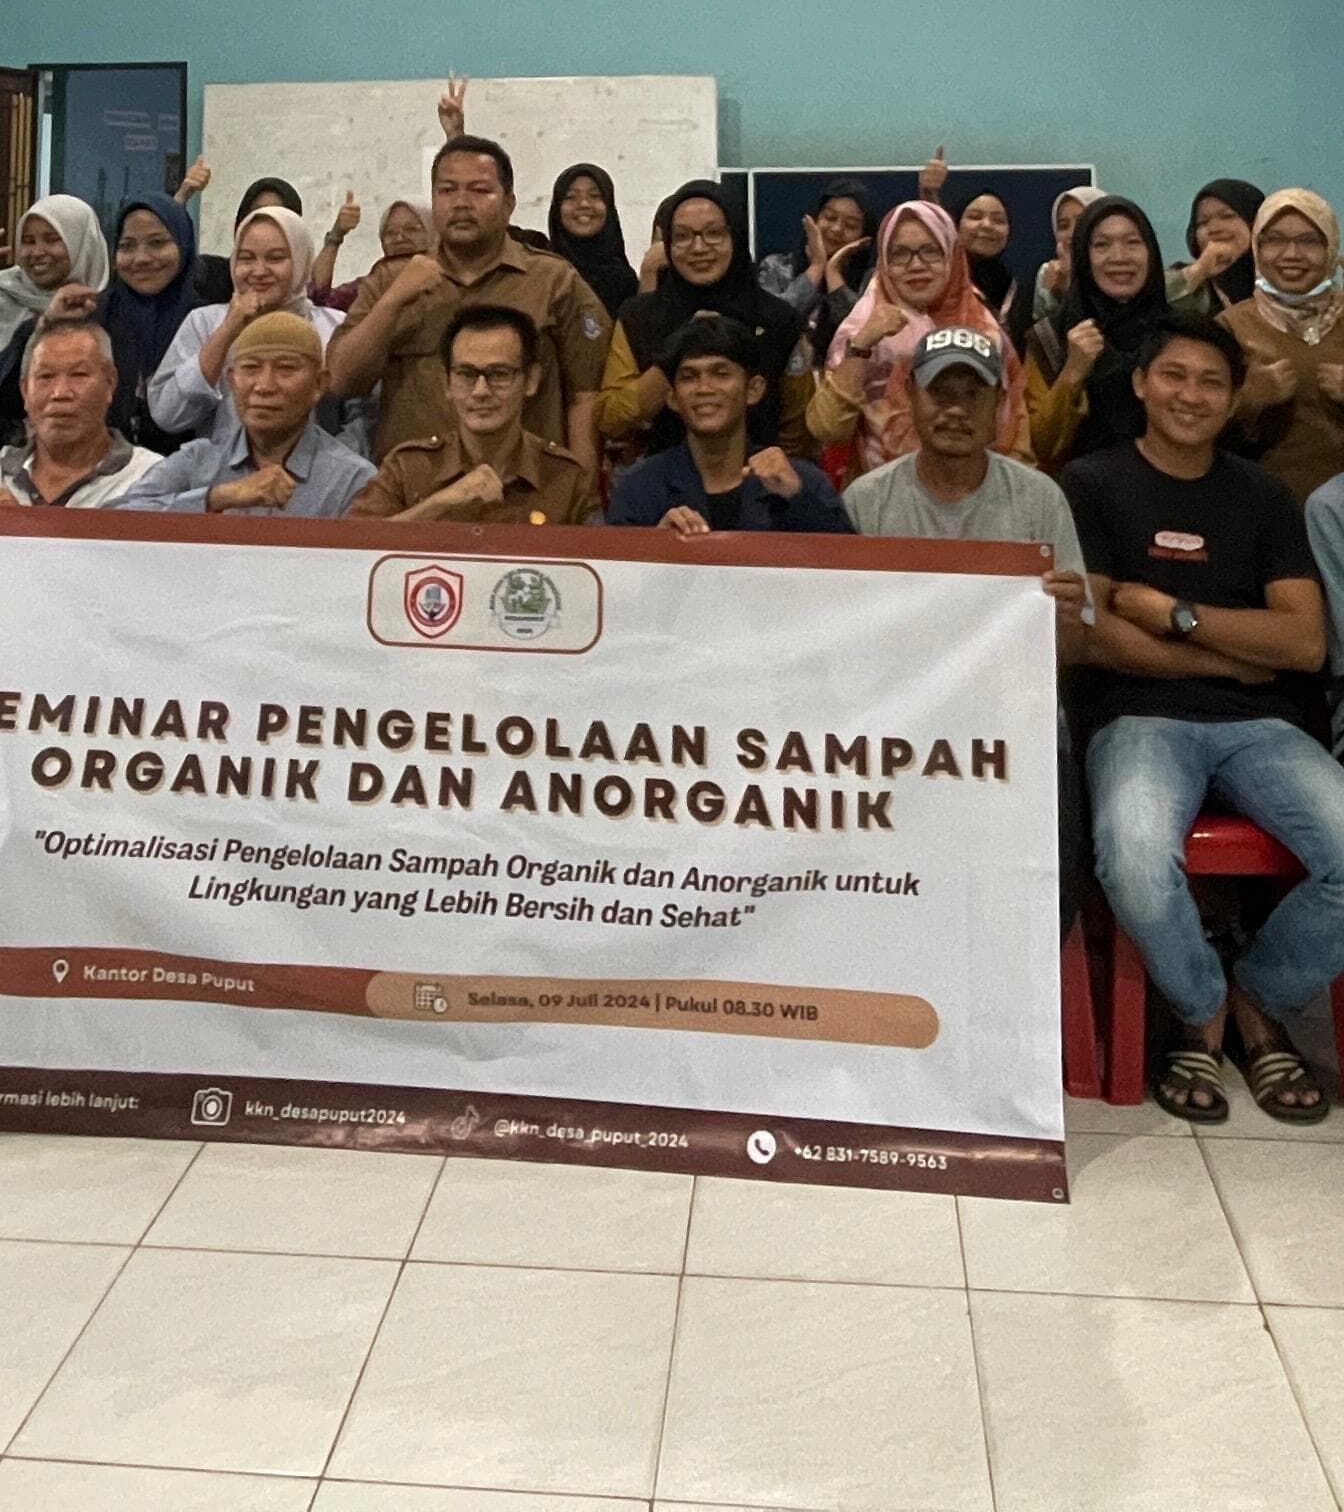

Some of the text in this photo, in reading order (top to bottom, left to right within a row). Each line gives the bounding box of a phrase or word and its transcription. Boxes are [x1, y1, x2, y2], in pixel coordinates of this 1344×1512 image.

[256, 702, 707, 767] PENGELOLAAN
[736, 728, 1009, 780] SAMPAH
[31, 746, 895, 831] ORGANIK DAN ANORGANIK
[35, 830, 921, 898] "Optimalisasi Pengelolaan Sampah Organik dan Anorganik untuk
[188, 875, 756, 928] Lingkungan yang Lebih Bersih dan Sehat"
[83, 964, 256, 993] Kantor Desa Puput
[467, 992, 534, 1009] Selasa,
[538, 993, 562, 1008] 09
[566, 993, 598, 1008] Juli
[603, 994, 651, 1009] 2024
[665, 996, 718, 1014] Pukul
[722, 999, 775, 1018] 08.30
[778, 1003, 819, 1022] WIB
[45, 1091, 85, 1108] lebih
[88, 1092, 140, 1112] lanjut:
[244, 1099, 407, 1126] kkn_desapuput2024
[825, 1146, 949, 1171] 831-7589-9563
